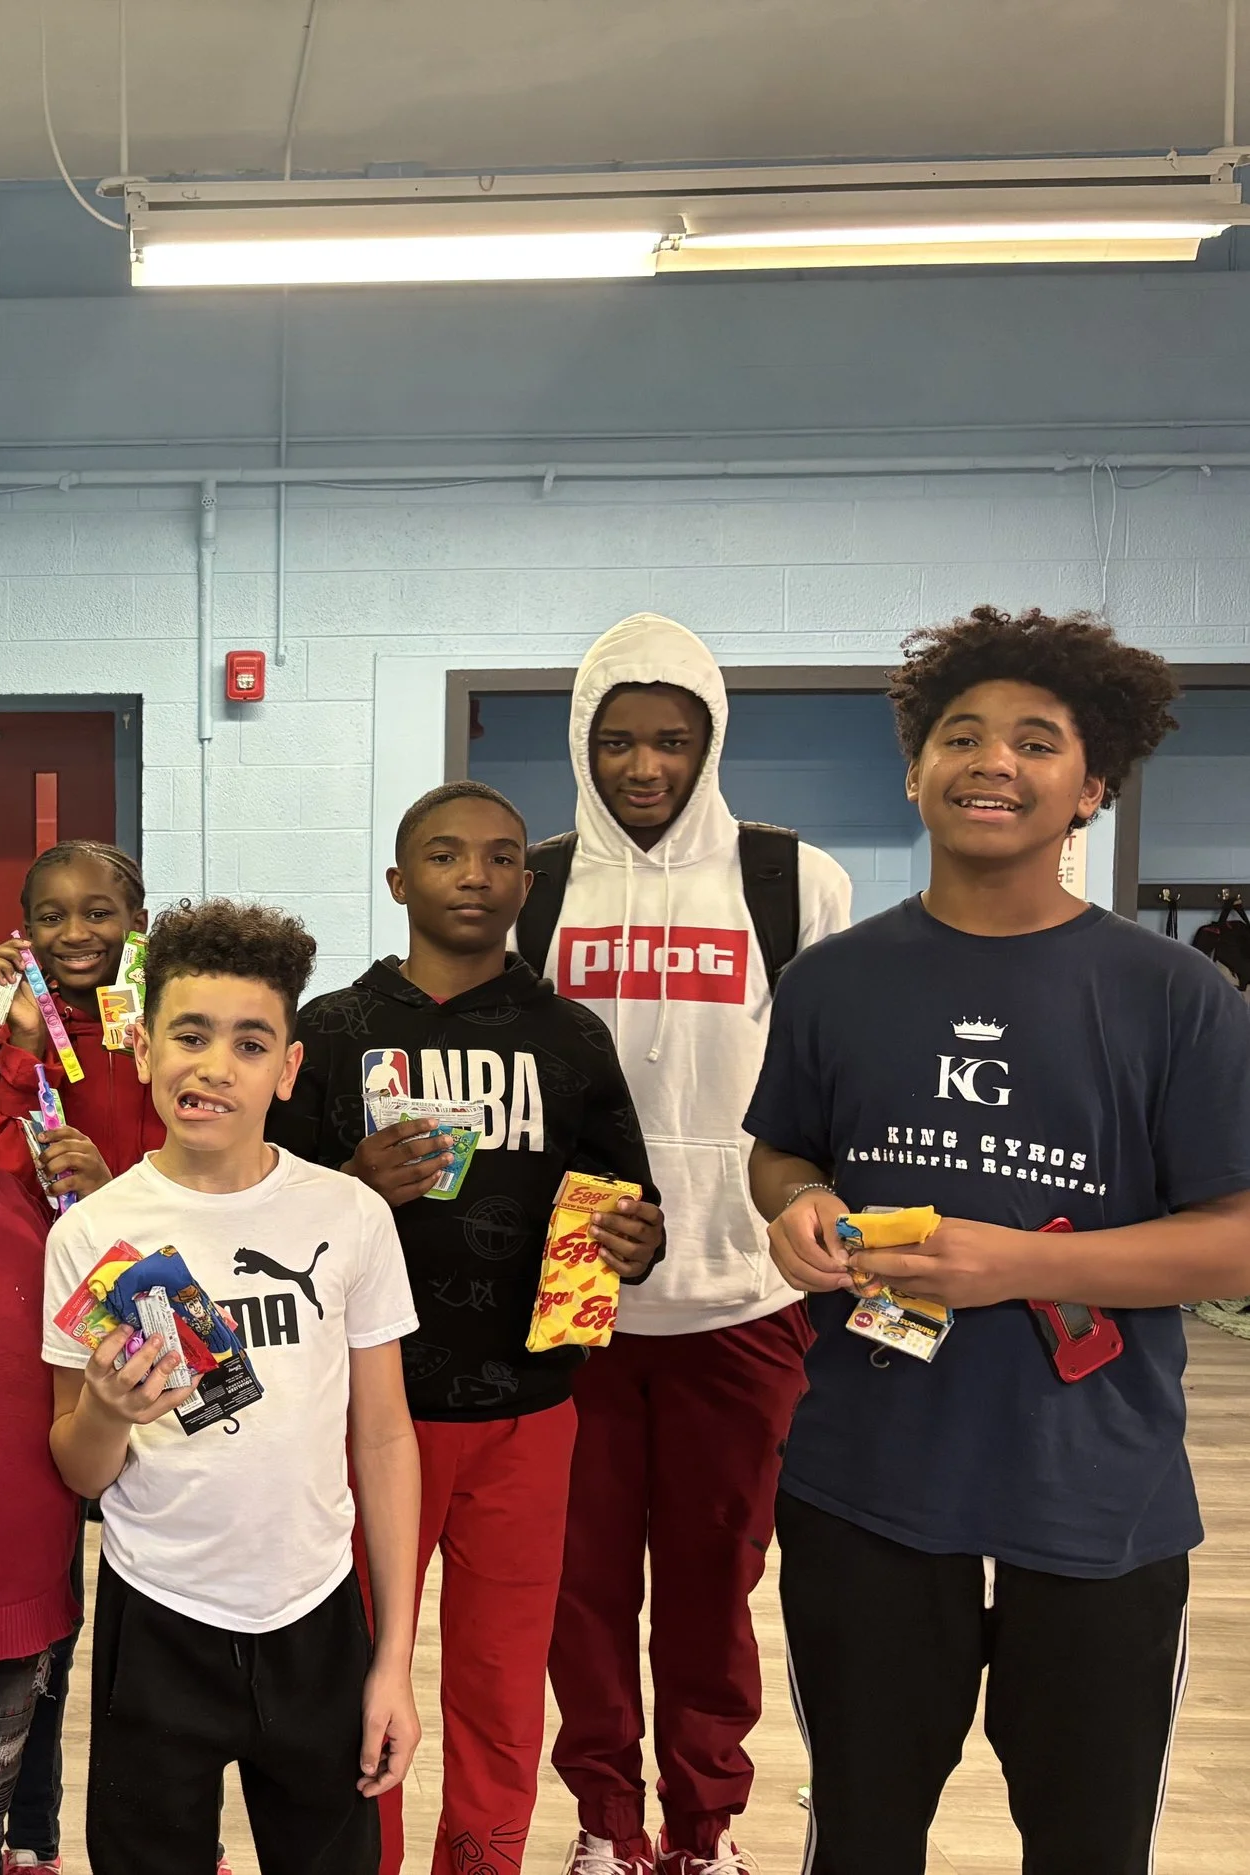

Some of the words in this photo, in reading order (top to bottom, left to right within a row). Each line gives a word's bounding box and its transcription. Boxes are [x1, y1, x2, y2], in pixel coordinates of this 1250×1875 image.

[570, 938, 734, 986] pilot
[420, 1049, 544, 1152] NBA
[934, 1054, 1013, 1106] KG
[887, 1126, 958, 1149] KING
[980, 1134, 1087, 1172] GYROS
[567, 1186, 613, 1205] Eggo
[549, 1232, 601, 1264] Egg
[572, 1295, 618, 1331] Egg
[898, 1318, 939, 1338] minions
